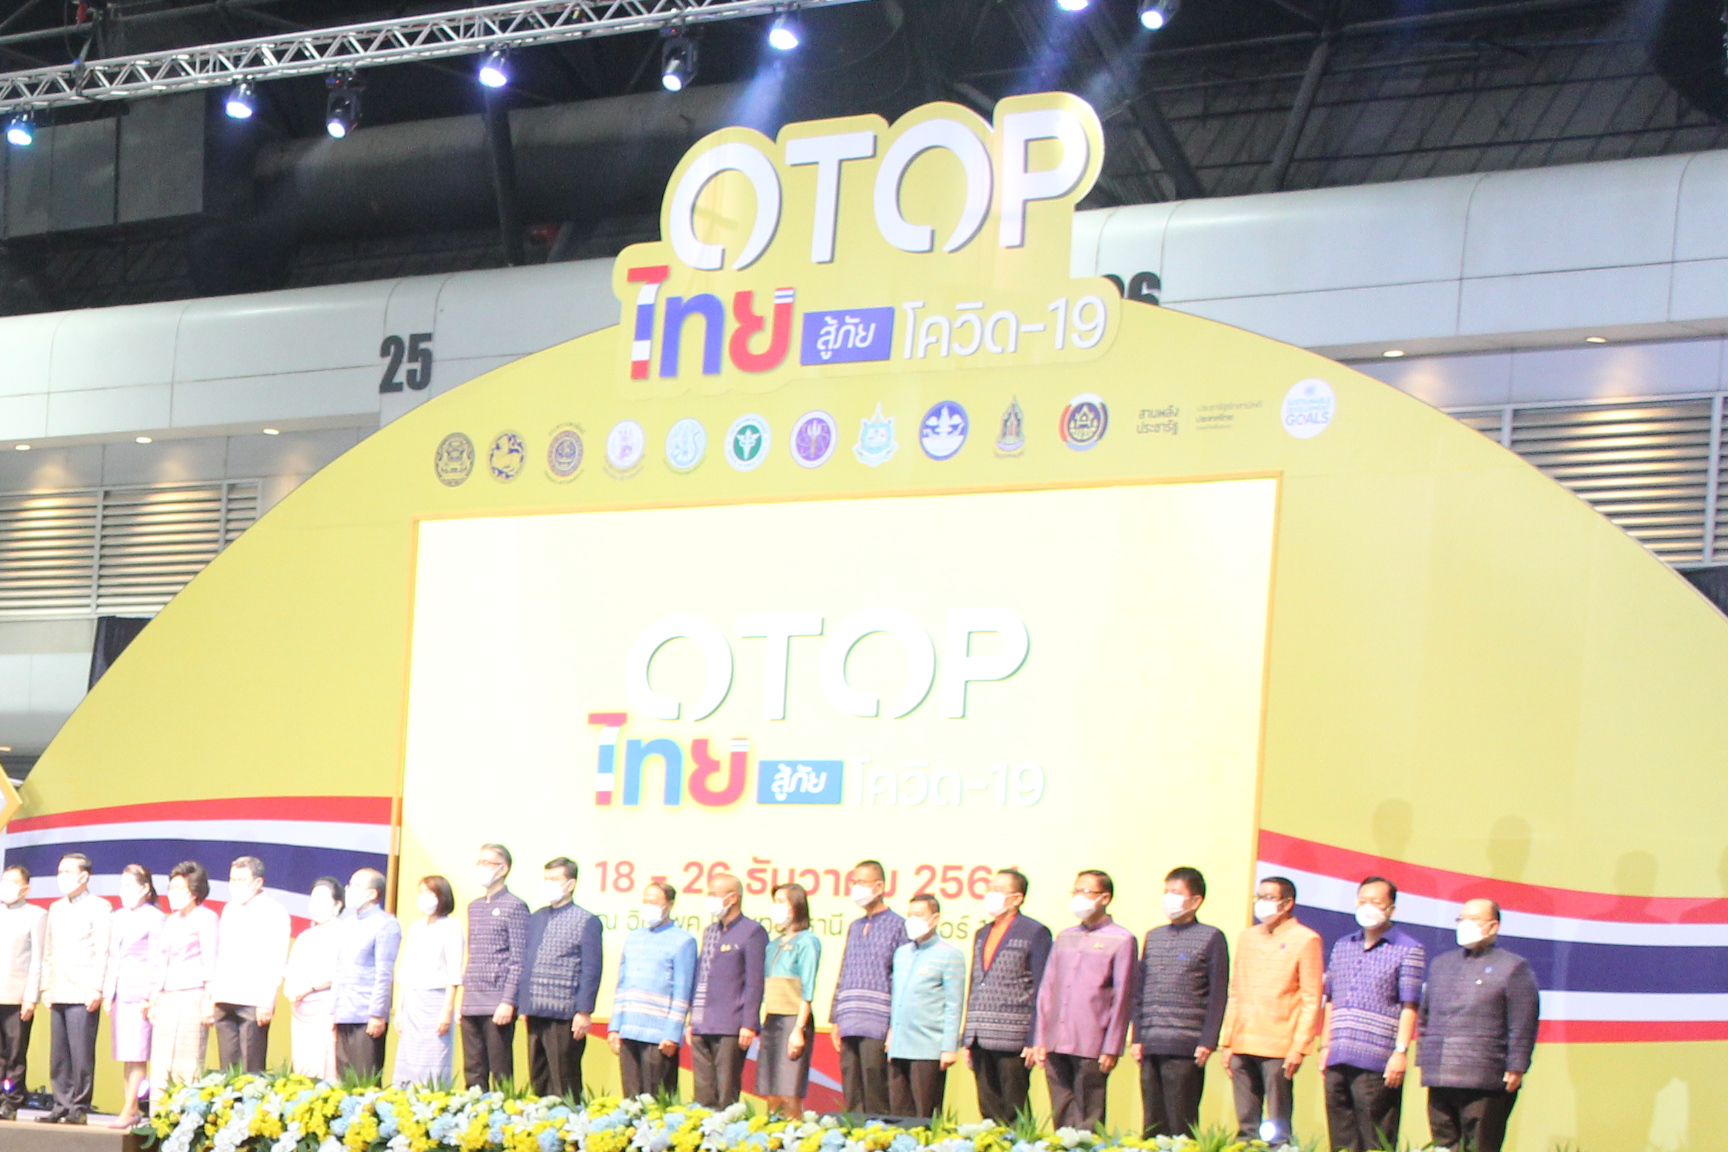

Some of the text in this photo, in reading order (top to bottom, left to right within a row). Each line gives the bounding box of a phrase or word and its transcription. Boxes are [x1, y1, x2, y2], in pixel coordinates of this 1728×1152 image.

[670, 109, 1091, 271] OTOP
[379, 332, 433, 394] 25
[627, 265, 1108, 379] ไทย สู้ภัย โควิด-19
[1285, 411, 1330, 426] GOALS
[625, 606, 1031, 722] OTOP
[588, 712, 750, 807] ไทย
[595, 860, 636, 893] 18
[913, 864, 1020, 900] 256
